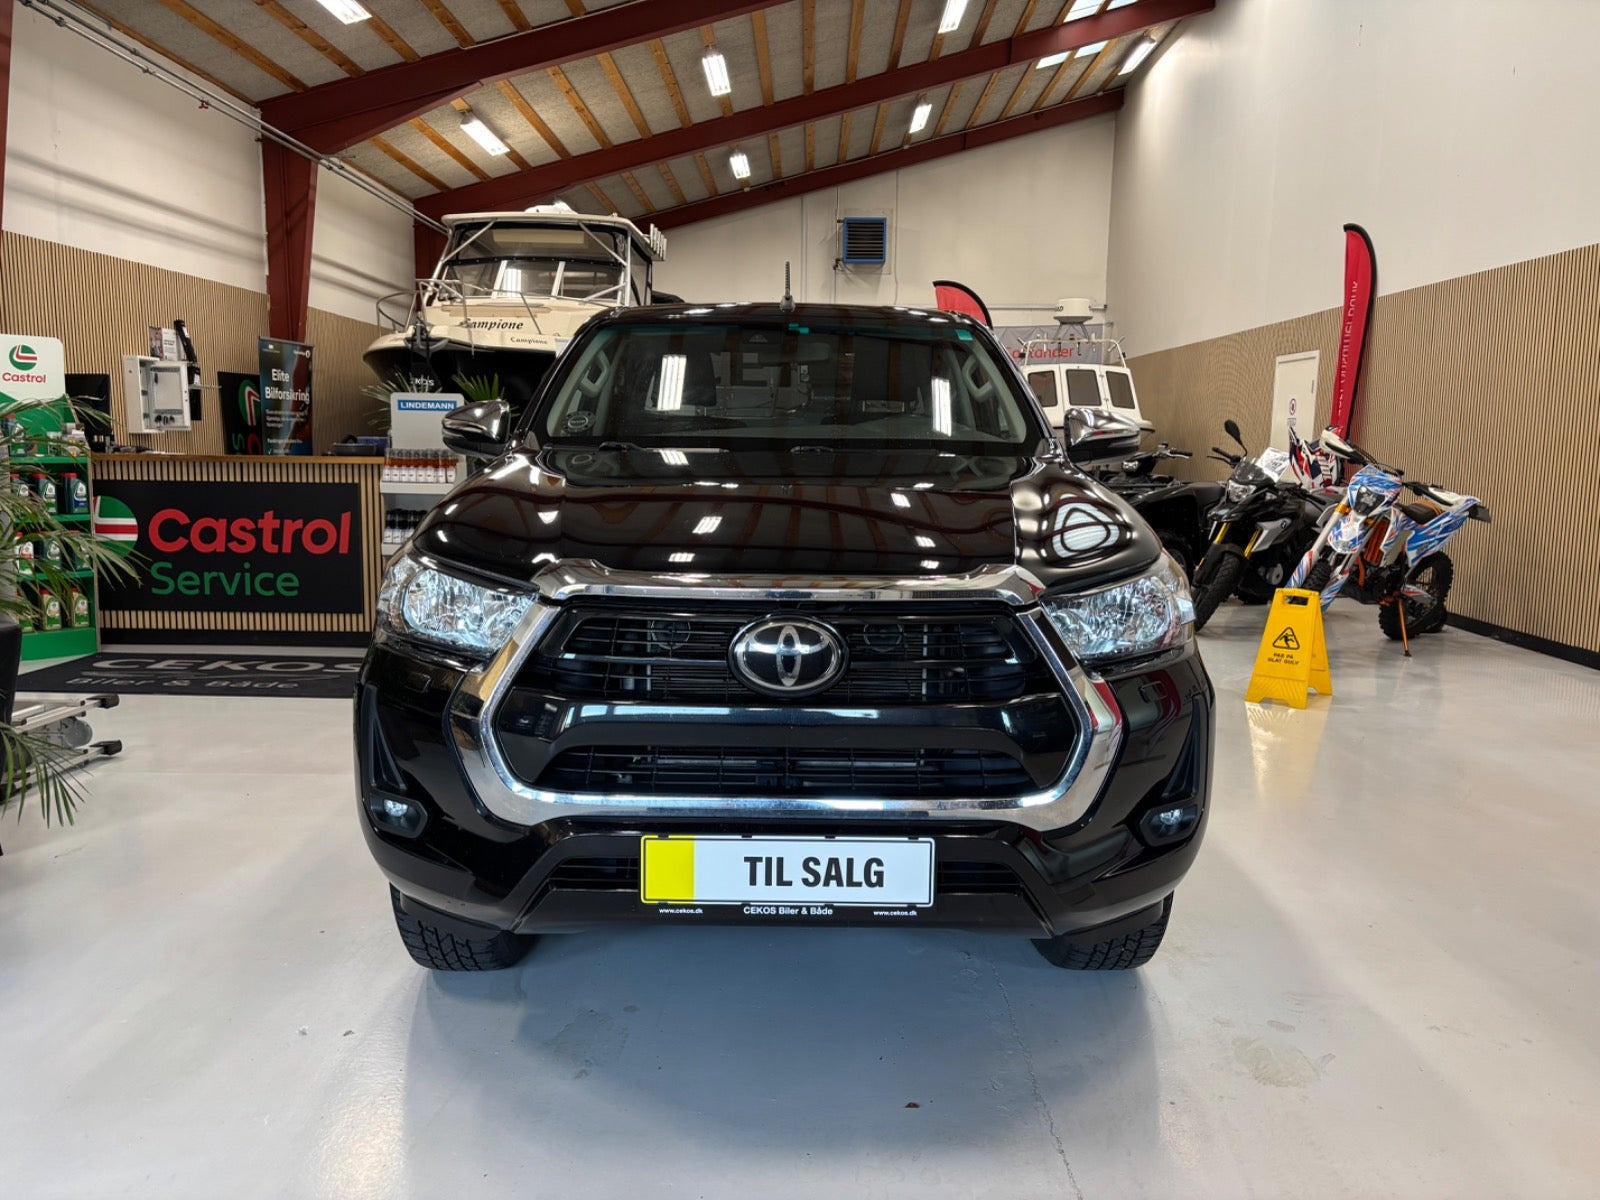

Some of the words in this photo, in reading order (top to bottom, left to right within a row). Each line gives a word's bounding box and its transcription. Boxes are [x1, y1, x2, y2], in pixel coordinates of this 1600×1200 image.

[2, 372, 46, 383] Castrol
[271, 368, 290, 382] Elite
[265, 386, 310, 405] Bilforsikring
[400, 402, 455, 410] LINDEMANN
[148, 508, 351, 554] Castrol
[150, 561, 300, 597] Service
[92, 658, 362, 673] CEKOS
[65, 678, 156, 686] Biler
[743, 856, 793, 887] TIL
[801, 856, 884, 888] SALG
[743, 906, 777, 915] CEKOS
[778, 906, 799, 915] Biler
[801, 907, 808, 915] &
[810, 905, 833, 915] Både
